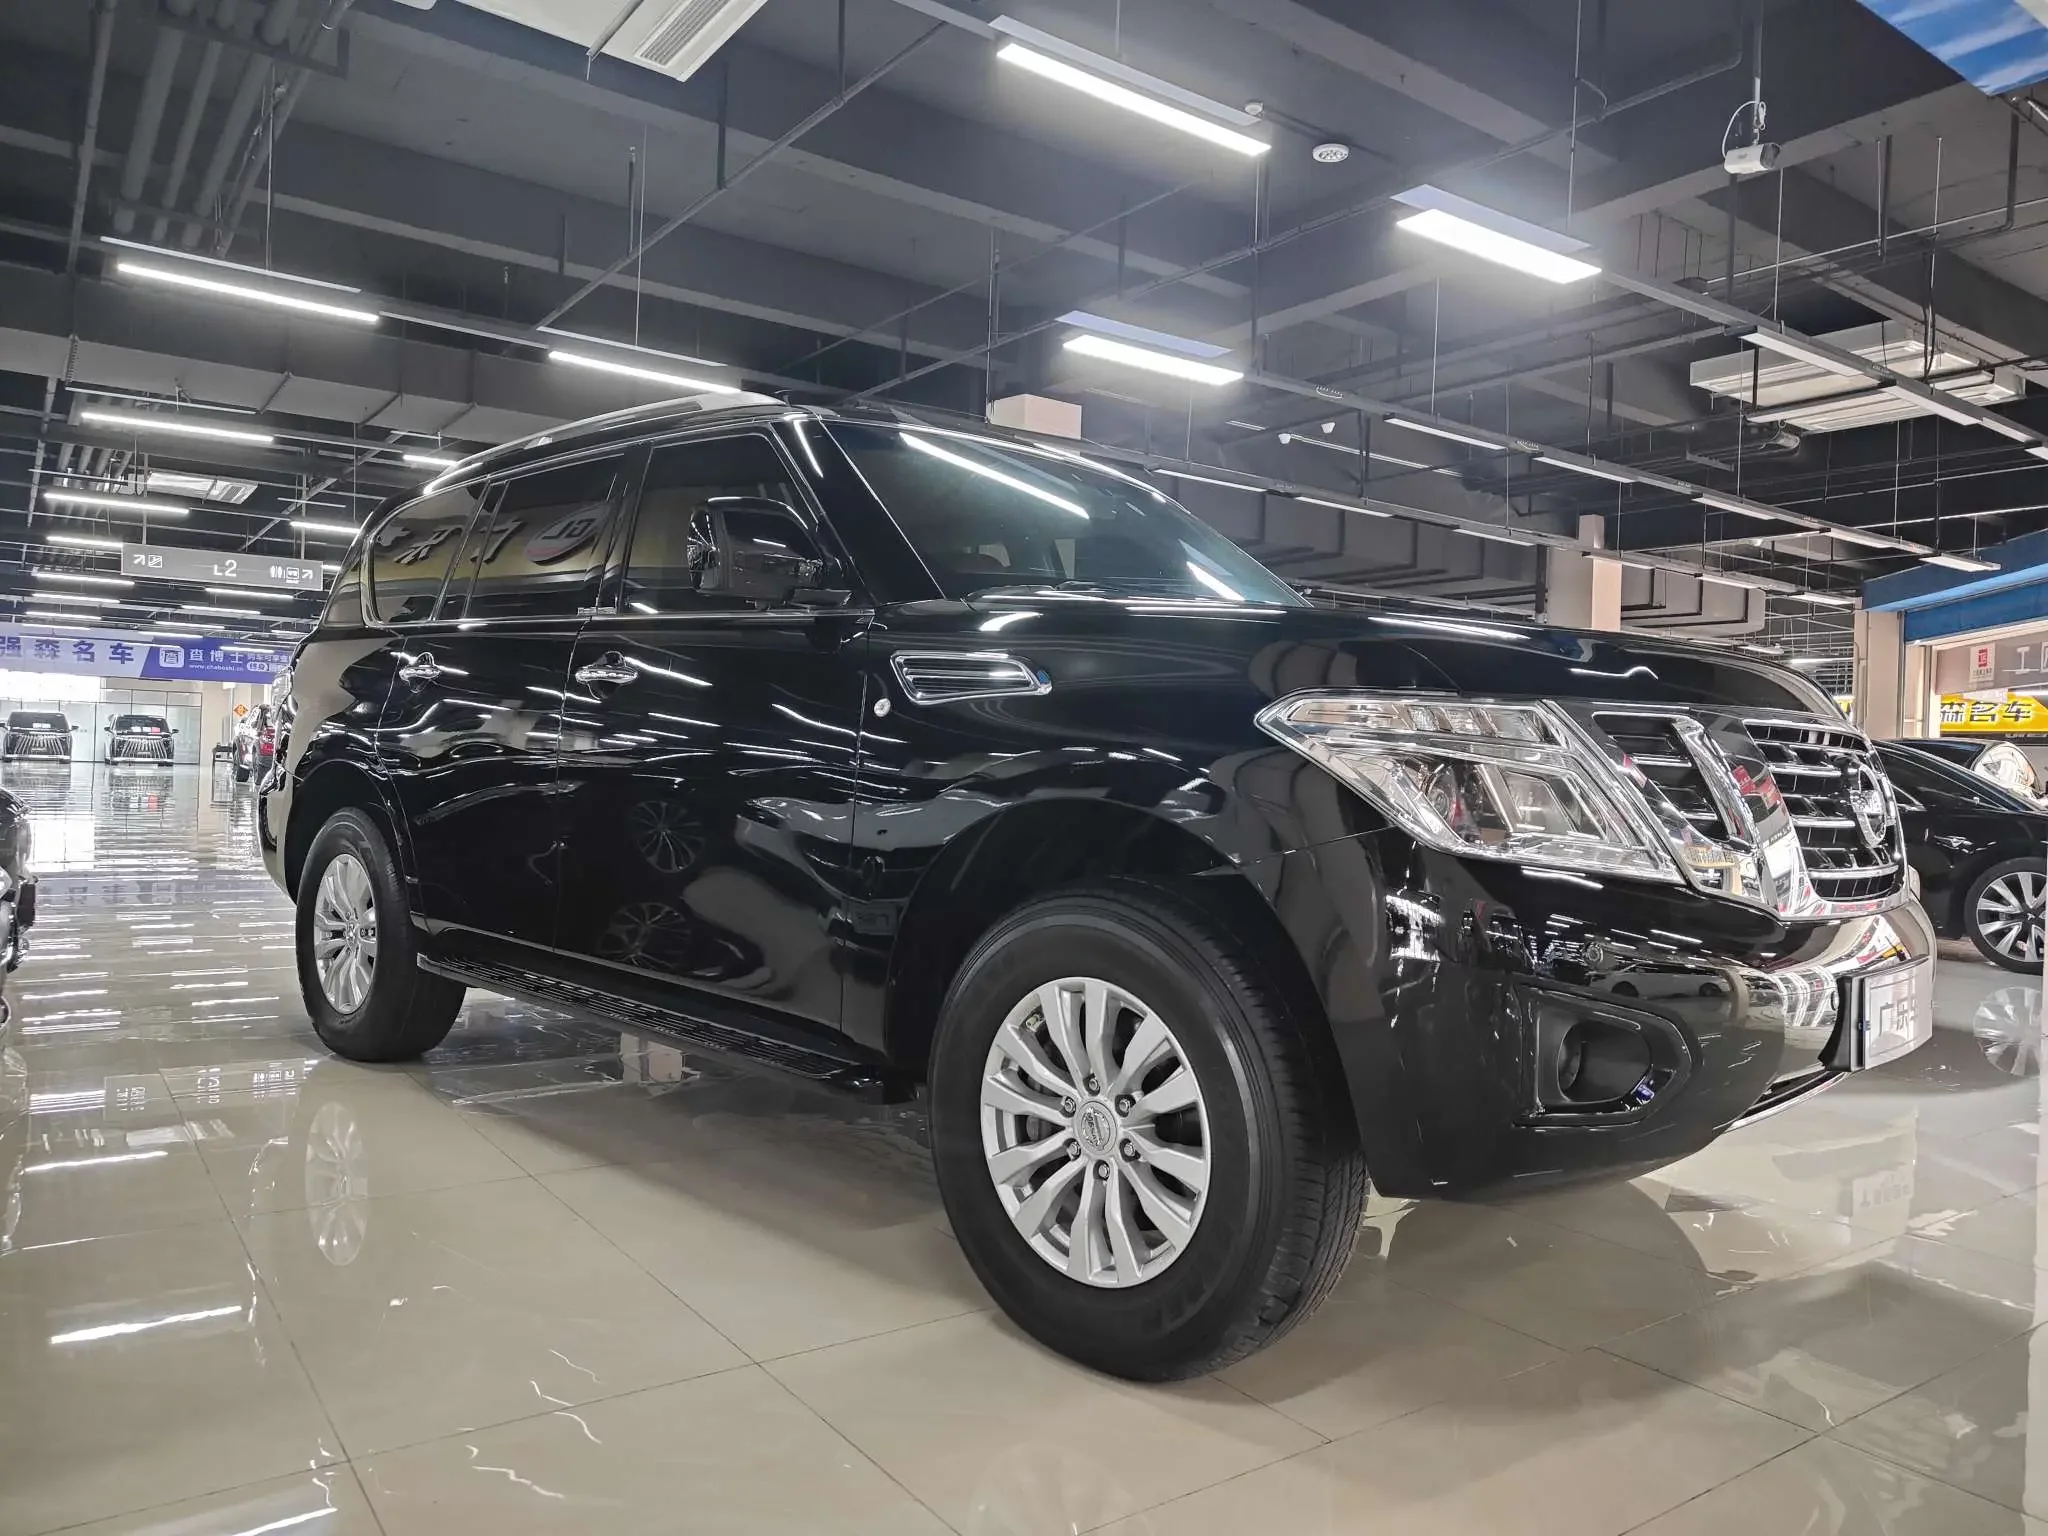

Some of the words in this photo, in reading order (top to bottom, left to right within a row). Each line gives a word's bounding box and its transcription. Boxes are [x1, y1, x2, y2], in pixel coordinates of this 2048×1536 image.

[212, 559, 238, 577] L2
[189, 648, 245, 664] 查博士
